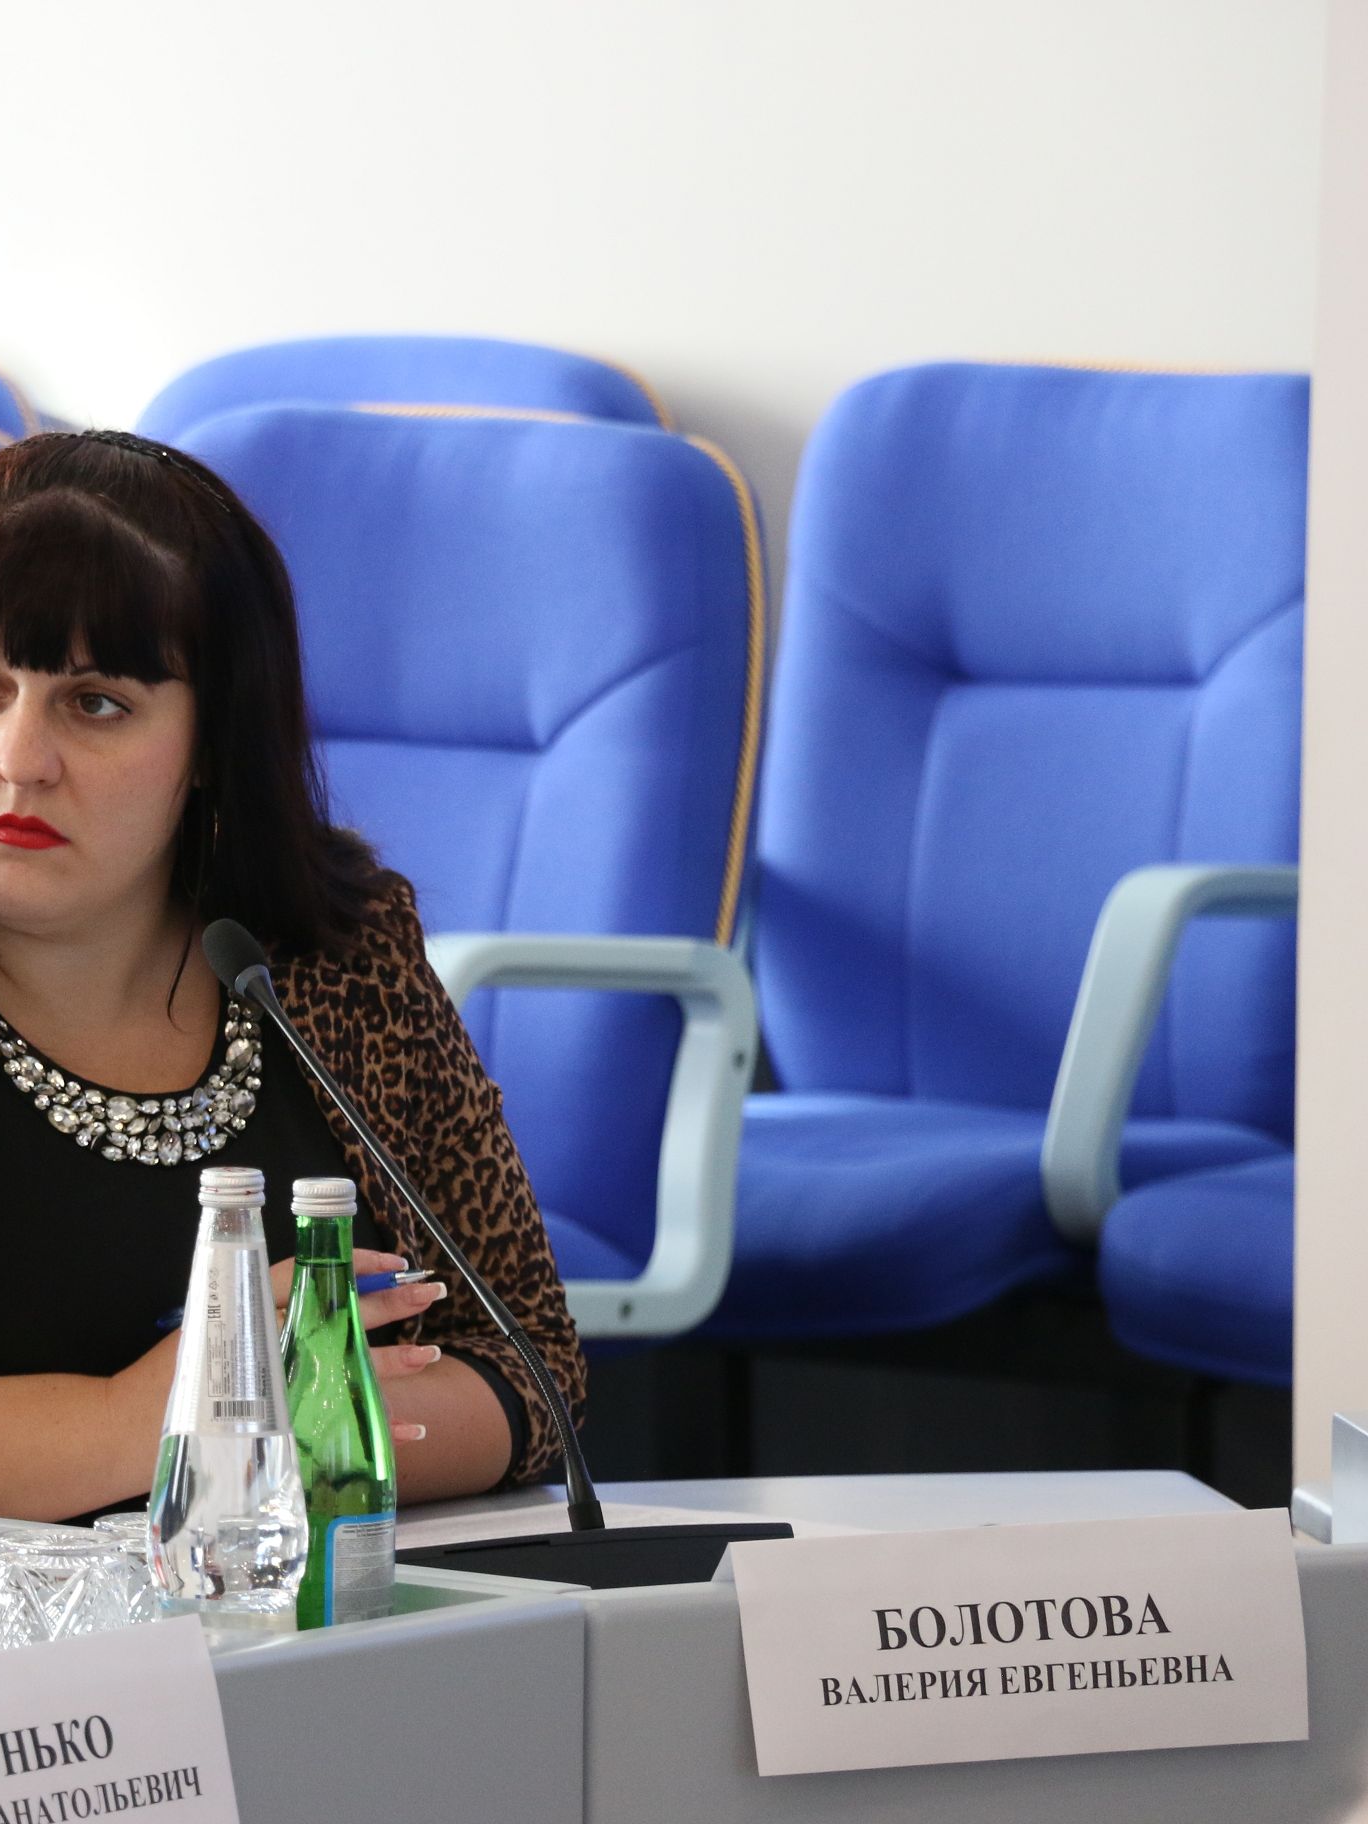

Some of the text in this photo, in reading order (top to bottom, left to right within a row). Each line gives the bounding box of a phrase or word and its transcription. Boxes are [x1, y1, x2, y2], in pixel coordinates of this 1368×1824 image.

[871, 1592, 1172, 1652] БОЛОТОВА
[819, 1653, 1235, 1707] ВАЛЕРИЯ ЕВГЕНЬЕВНА
